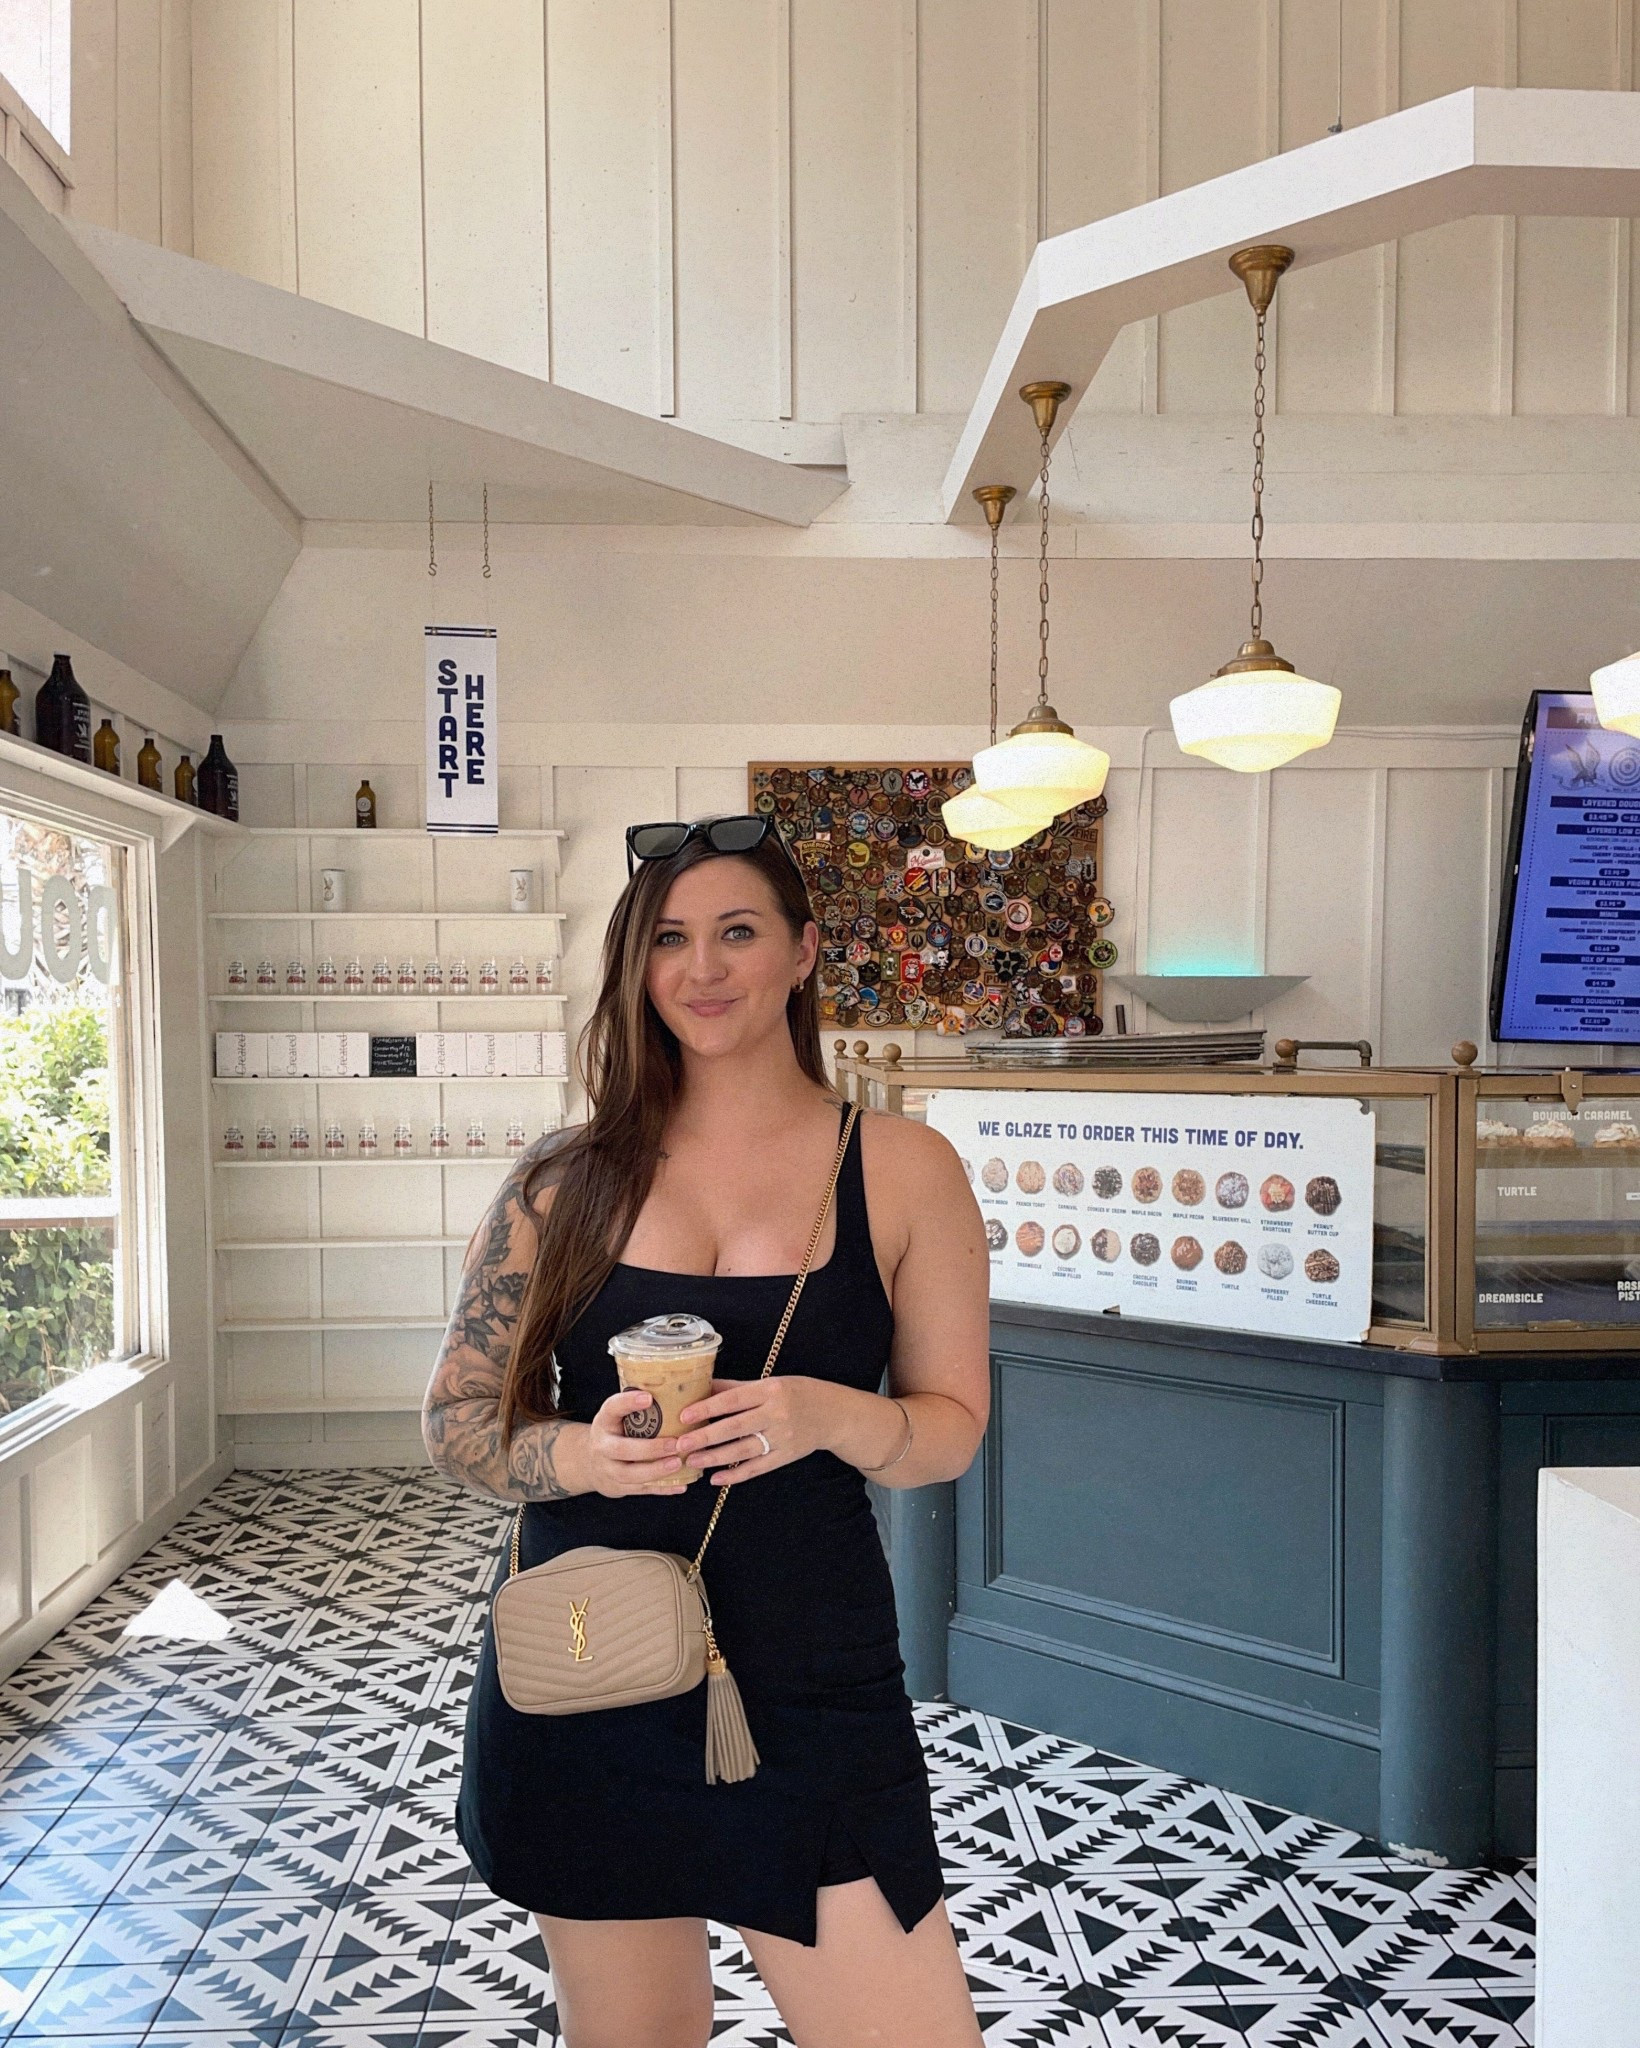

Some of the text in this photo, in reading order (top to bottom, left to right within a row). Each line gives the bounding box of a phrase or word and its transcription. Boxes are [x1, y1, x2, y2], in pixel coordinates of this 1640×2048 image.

[438, 659, 459, 798] START
[465, 674, 485, 785] HERE
[1075, 830, 1096, 840] FIRE
[234, 1033, 246, 1075] Created
[285, 1034, 298, 1075] Created
[336, 1034, 348, 1075] Created
[434, 1034, 446, 1074] Created
[484, 1034, 496, 1074] Created
[1584, 1110, 1633, 1120] CARAMEL
[978, 1121, 1304, 1149] WE GLAZE TO ORDER THIS TIME OF DAY.
[1497, 1186, 1537, 1197] TURTLE
[1176, 1278, 1198, 1286] BOURBON
[1260, 1287, 1289, 1295] RASPBERRY
[1478, 1293, 1544, 1304] DREAMSICLE
[1305, 1299, 1338, 1307] CHEESECAKE
[568, 1597, 593, 1662] YSL
